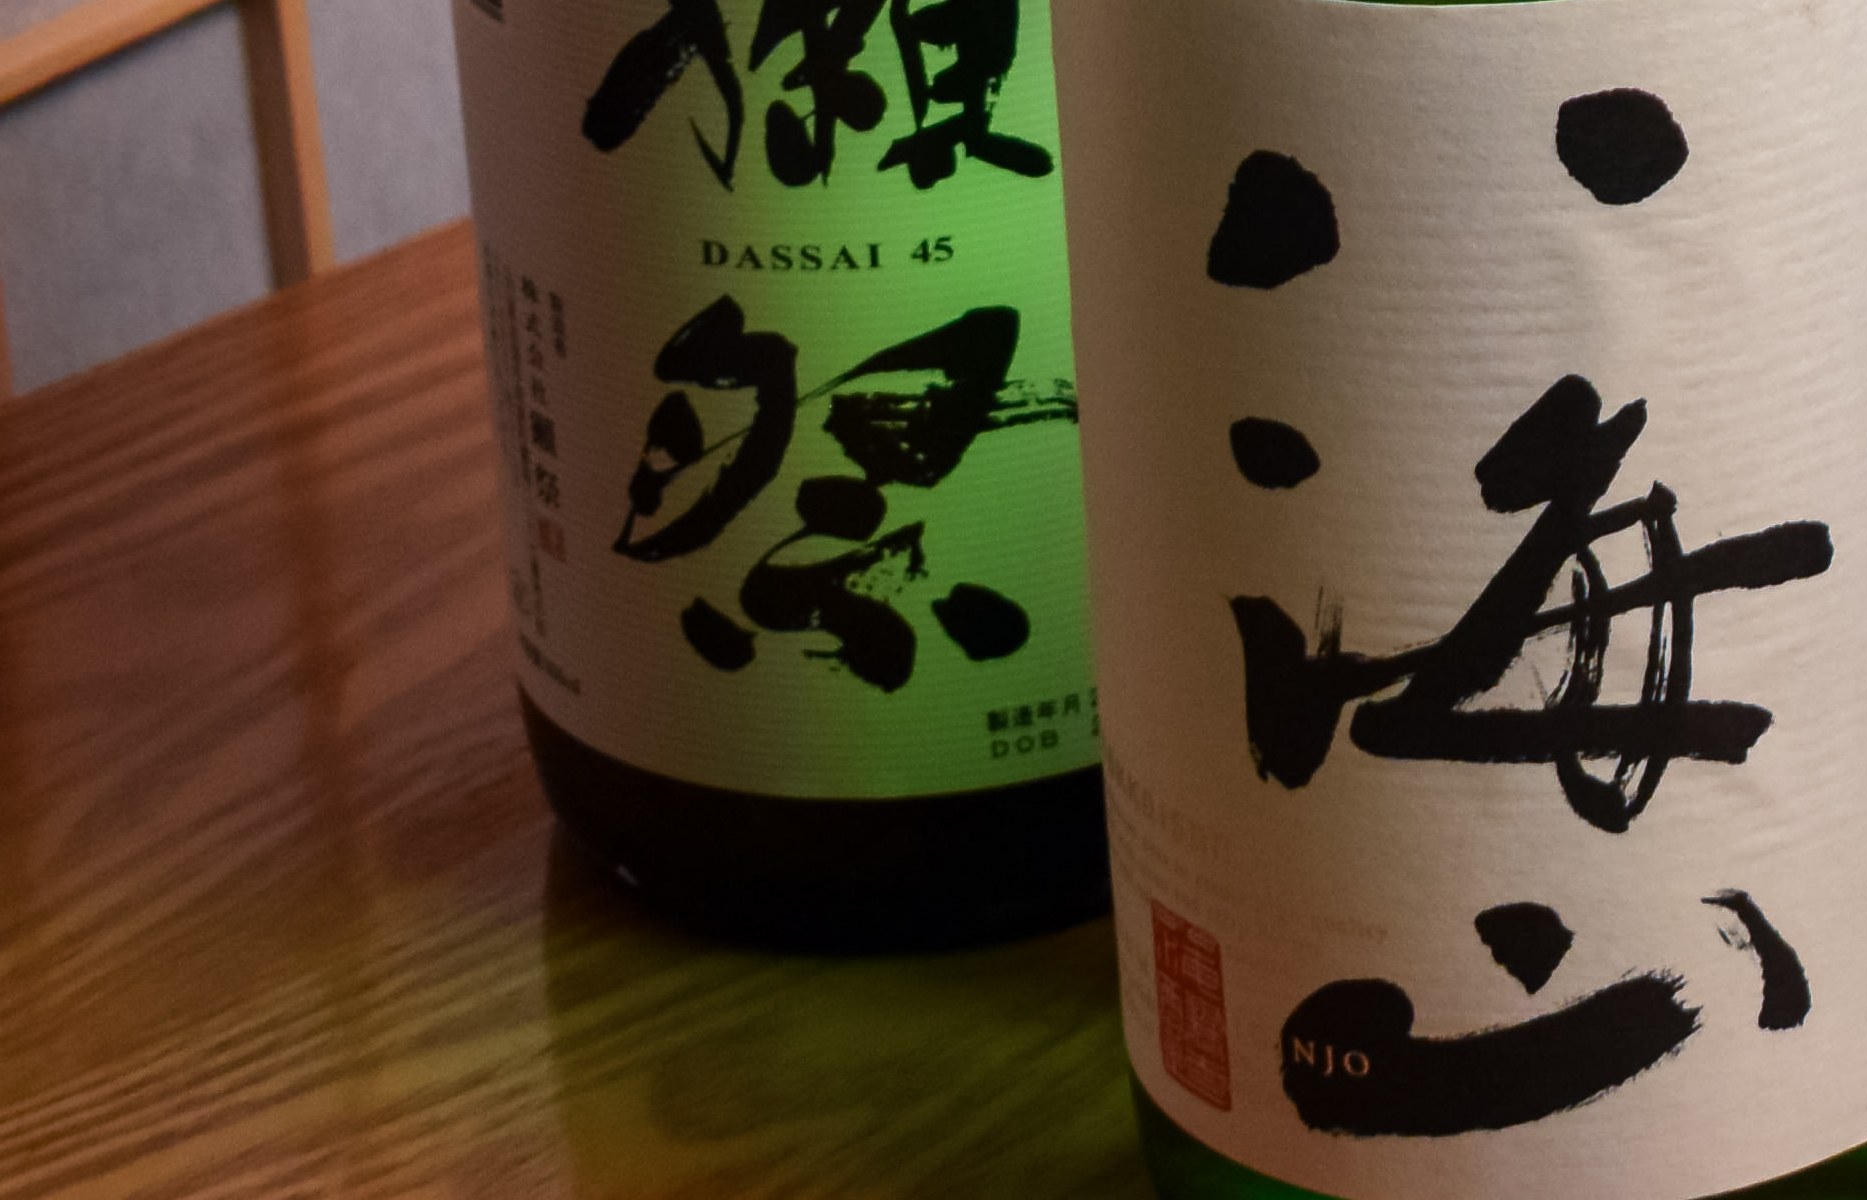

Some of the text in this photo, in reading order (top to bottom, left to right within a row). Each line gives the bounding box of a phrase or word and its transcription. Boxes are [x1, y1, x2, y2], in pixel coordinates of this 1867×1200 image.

[698, 235, 956, 273] DASSAI 45
[1208, 86, 1836, 1138] 八海山
[990, 728, 1060, 759] DOB
